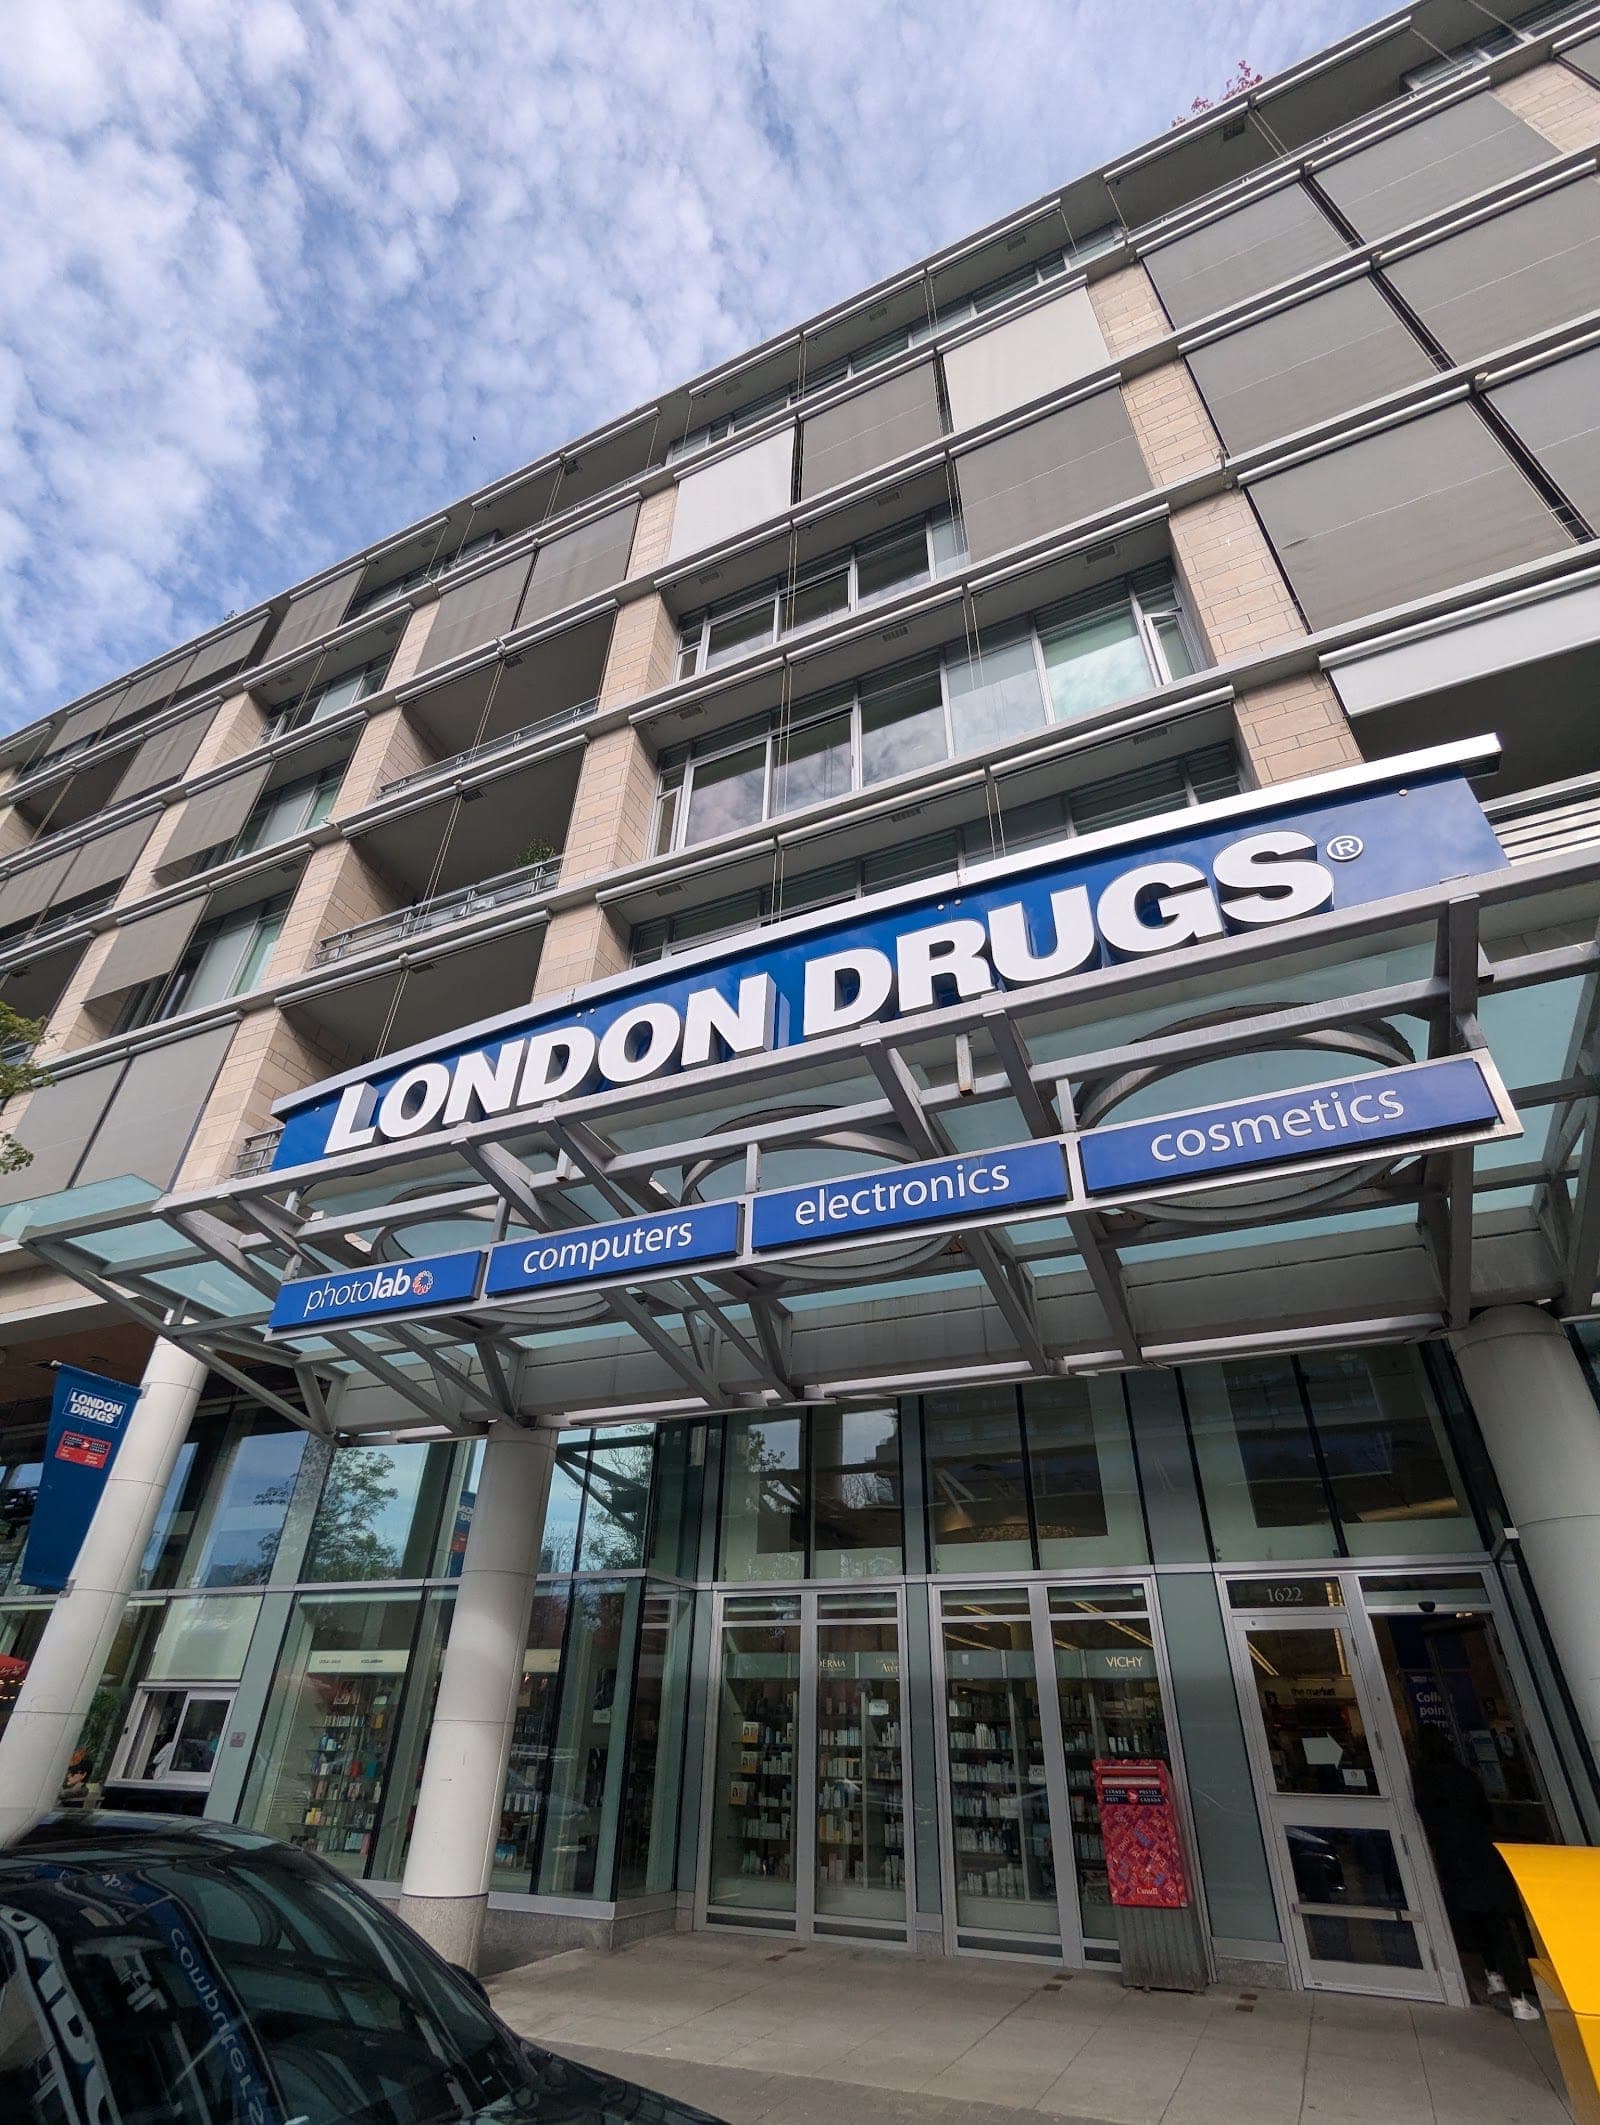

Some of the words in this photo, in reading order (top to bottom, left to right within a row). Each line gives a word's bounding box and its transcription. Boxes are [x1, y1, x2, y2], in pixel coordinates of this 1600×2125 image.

[325, 973, 776, 1154] LONDON
[1151, 1084, 1405, 1163] cosmetics
[795, 1161, 1011, 1227] electronics
[522, 1219, 693, 1275] computers
[303, 1268, 411, 1318] photolab
[70, 1391, 123, 1415] LONDON
[70, 1403, 114, 1424] DRUGS
[1266, 1586, 1304, 1602] 1622
[1105, 1656, 1142, 1667] VICHY
[1416, 1692, 1453, 1703] Collt
